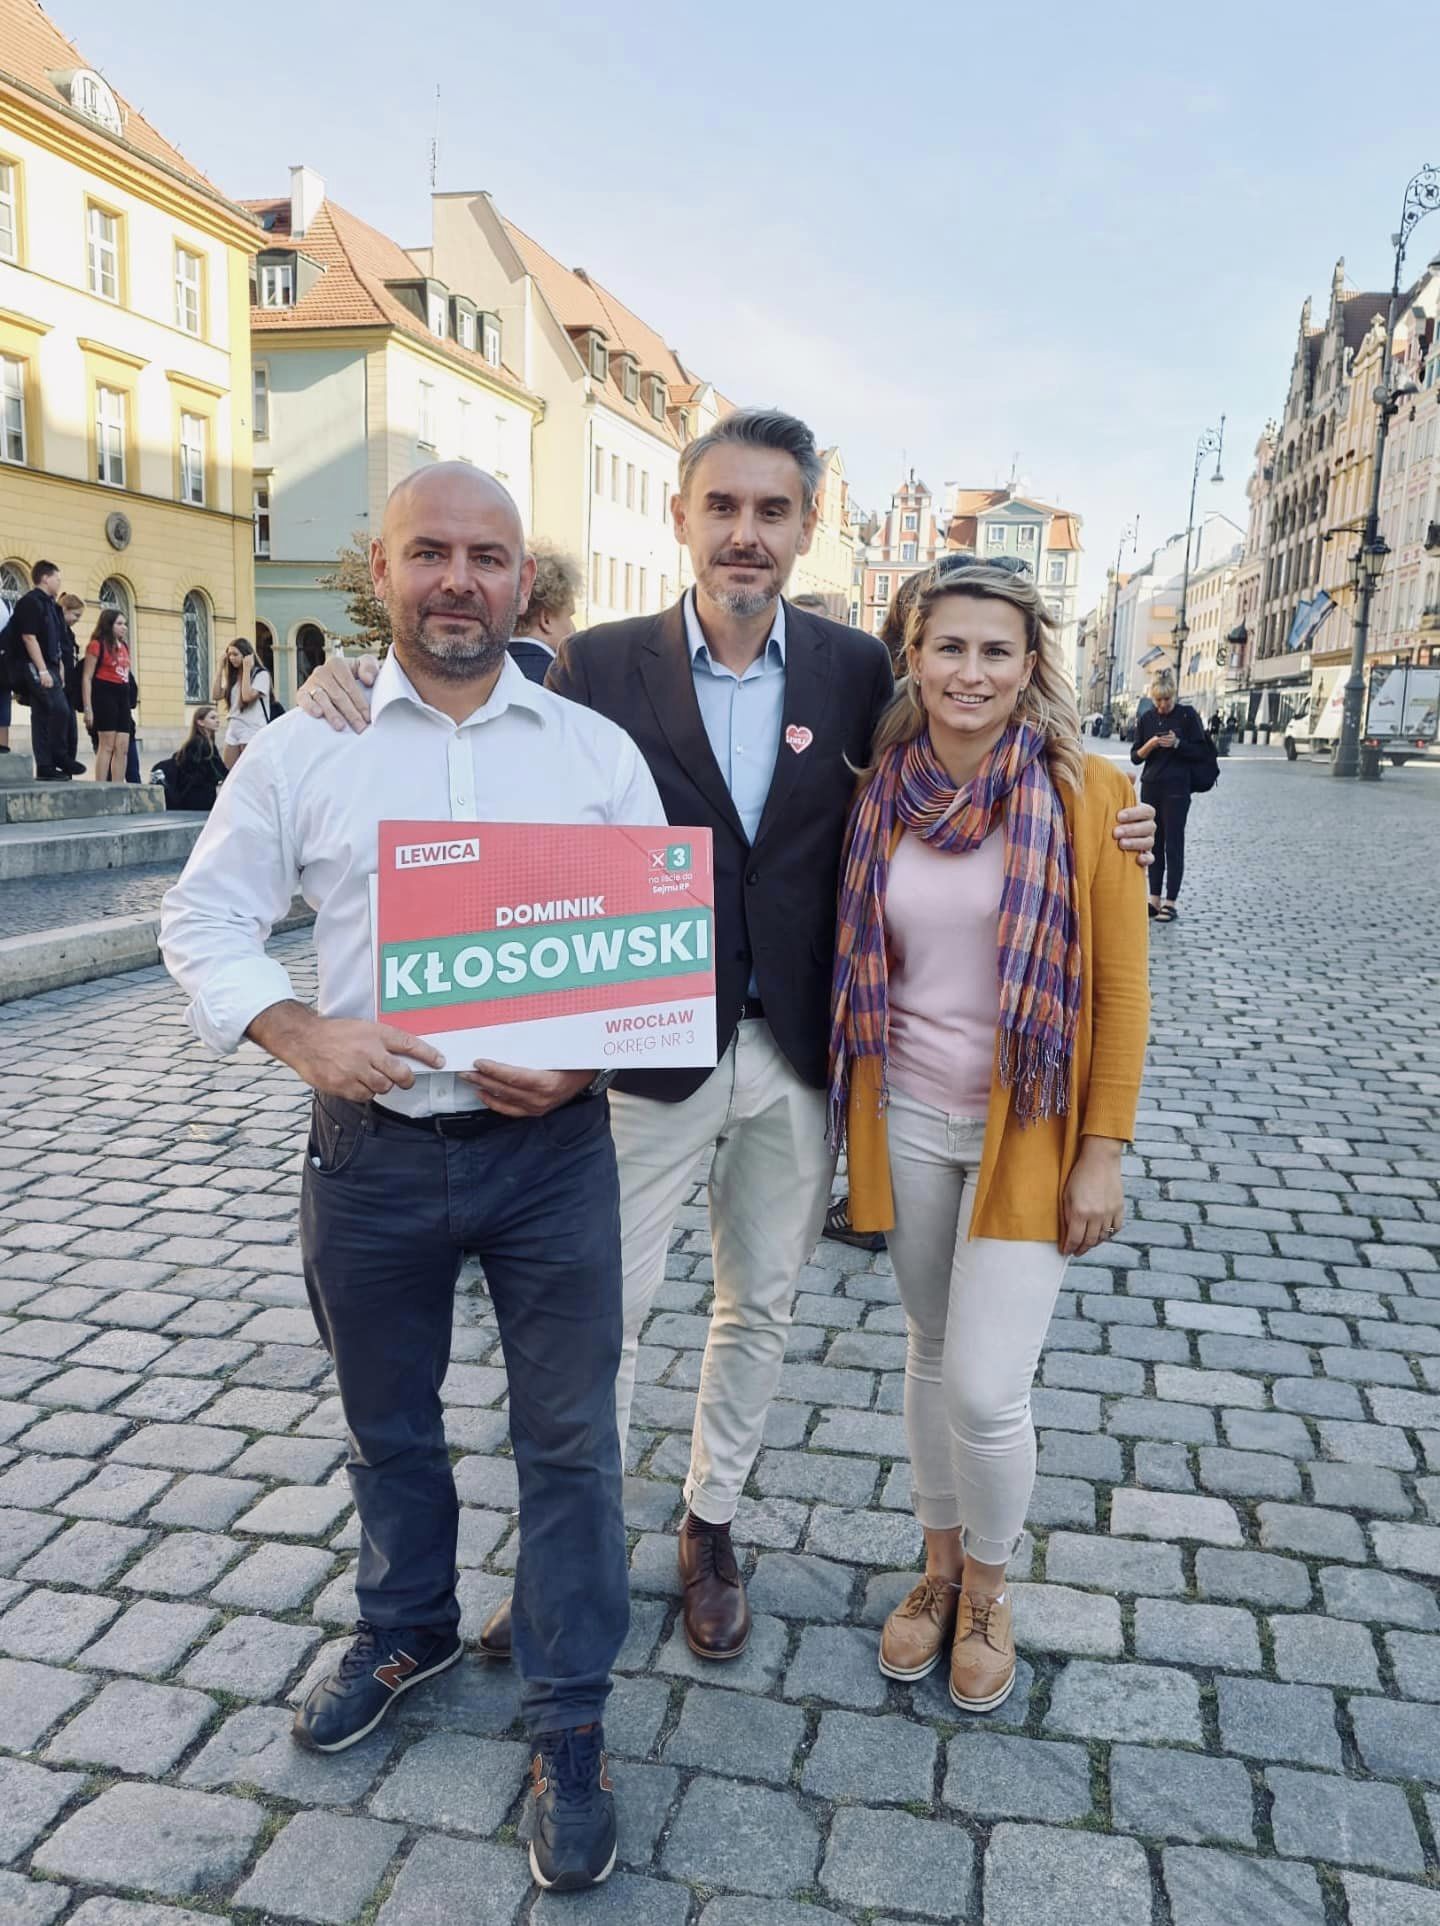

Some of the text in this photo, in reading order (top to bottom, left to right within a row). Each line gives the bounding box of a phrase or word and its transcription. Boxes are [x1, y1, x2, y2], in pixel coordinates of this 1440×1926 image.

[401, 842, 476, 865] LEWICA
[673, 847, 686, 867] 3
[496, 895, 606, 927] DOMINIK
[385, 919, 709, 999] KŁOSOWSKI
[605, 1009, 694, 1034] WROCŁAW
[603, 1030, 696, 1056] OKRĘG NR 3
